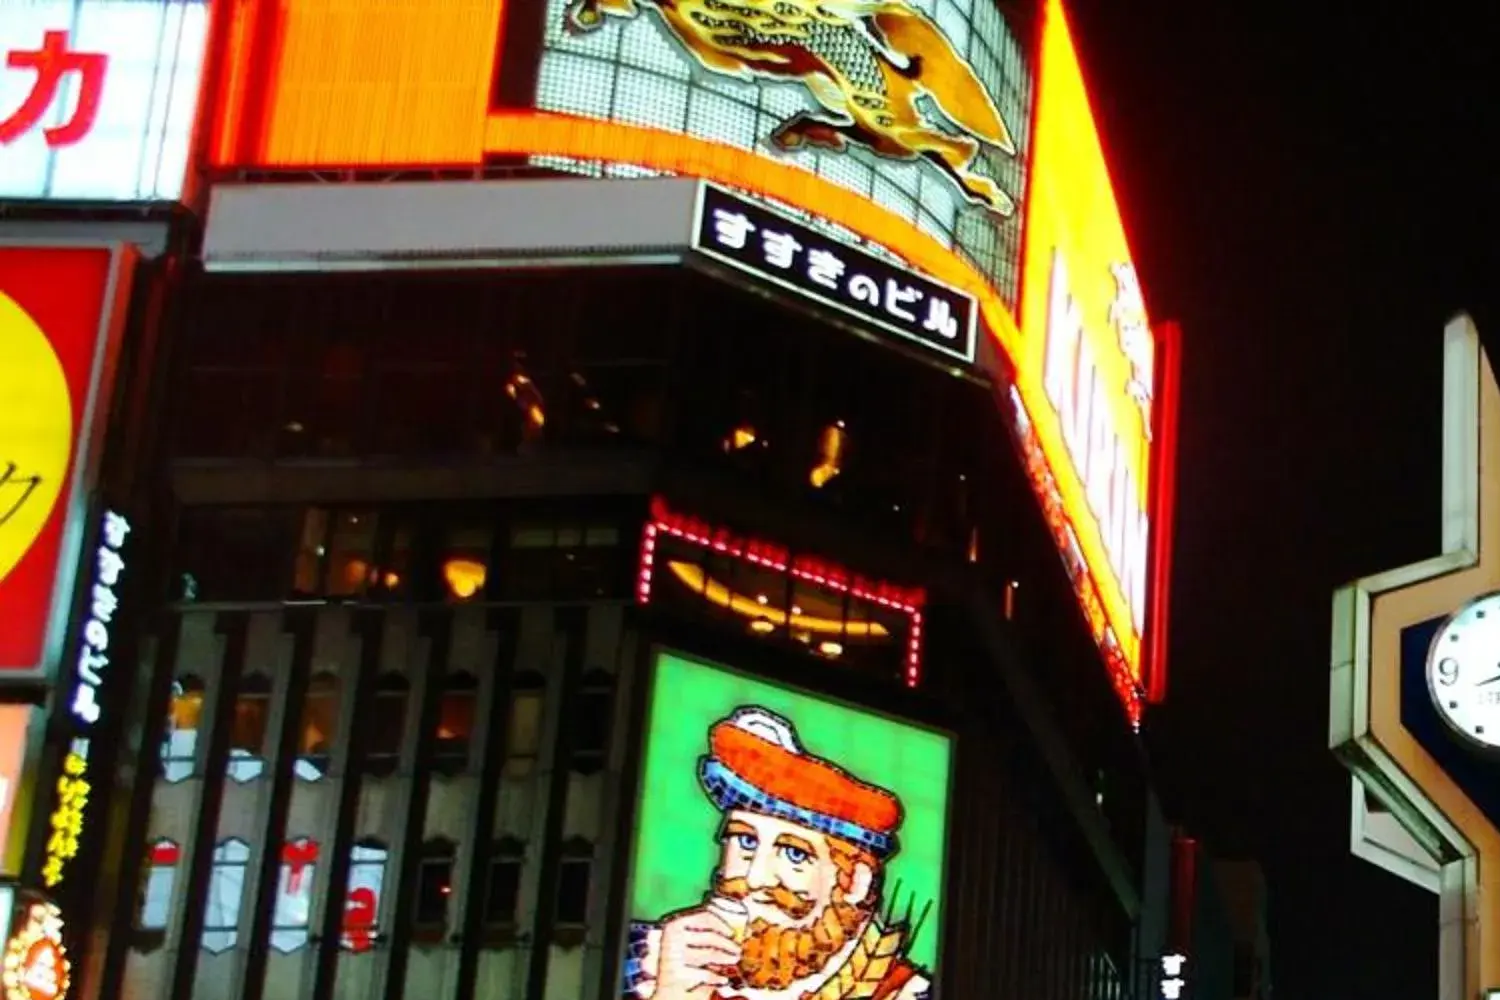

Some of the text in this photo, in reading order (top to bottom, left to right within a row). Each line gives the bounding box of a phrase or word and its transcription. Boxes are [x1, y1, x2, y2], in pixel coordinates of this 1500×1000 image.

[713, 208, 959, 340] すすきのビル
[1438, 657, 1460, 687] 9
